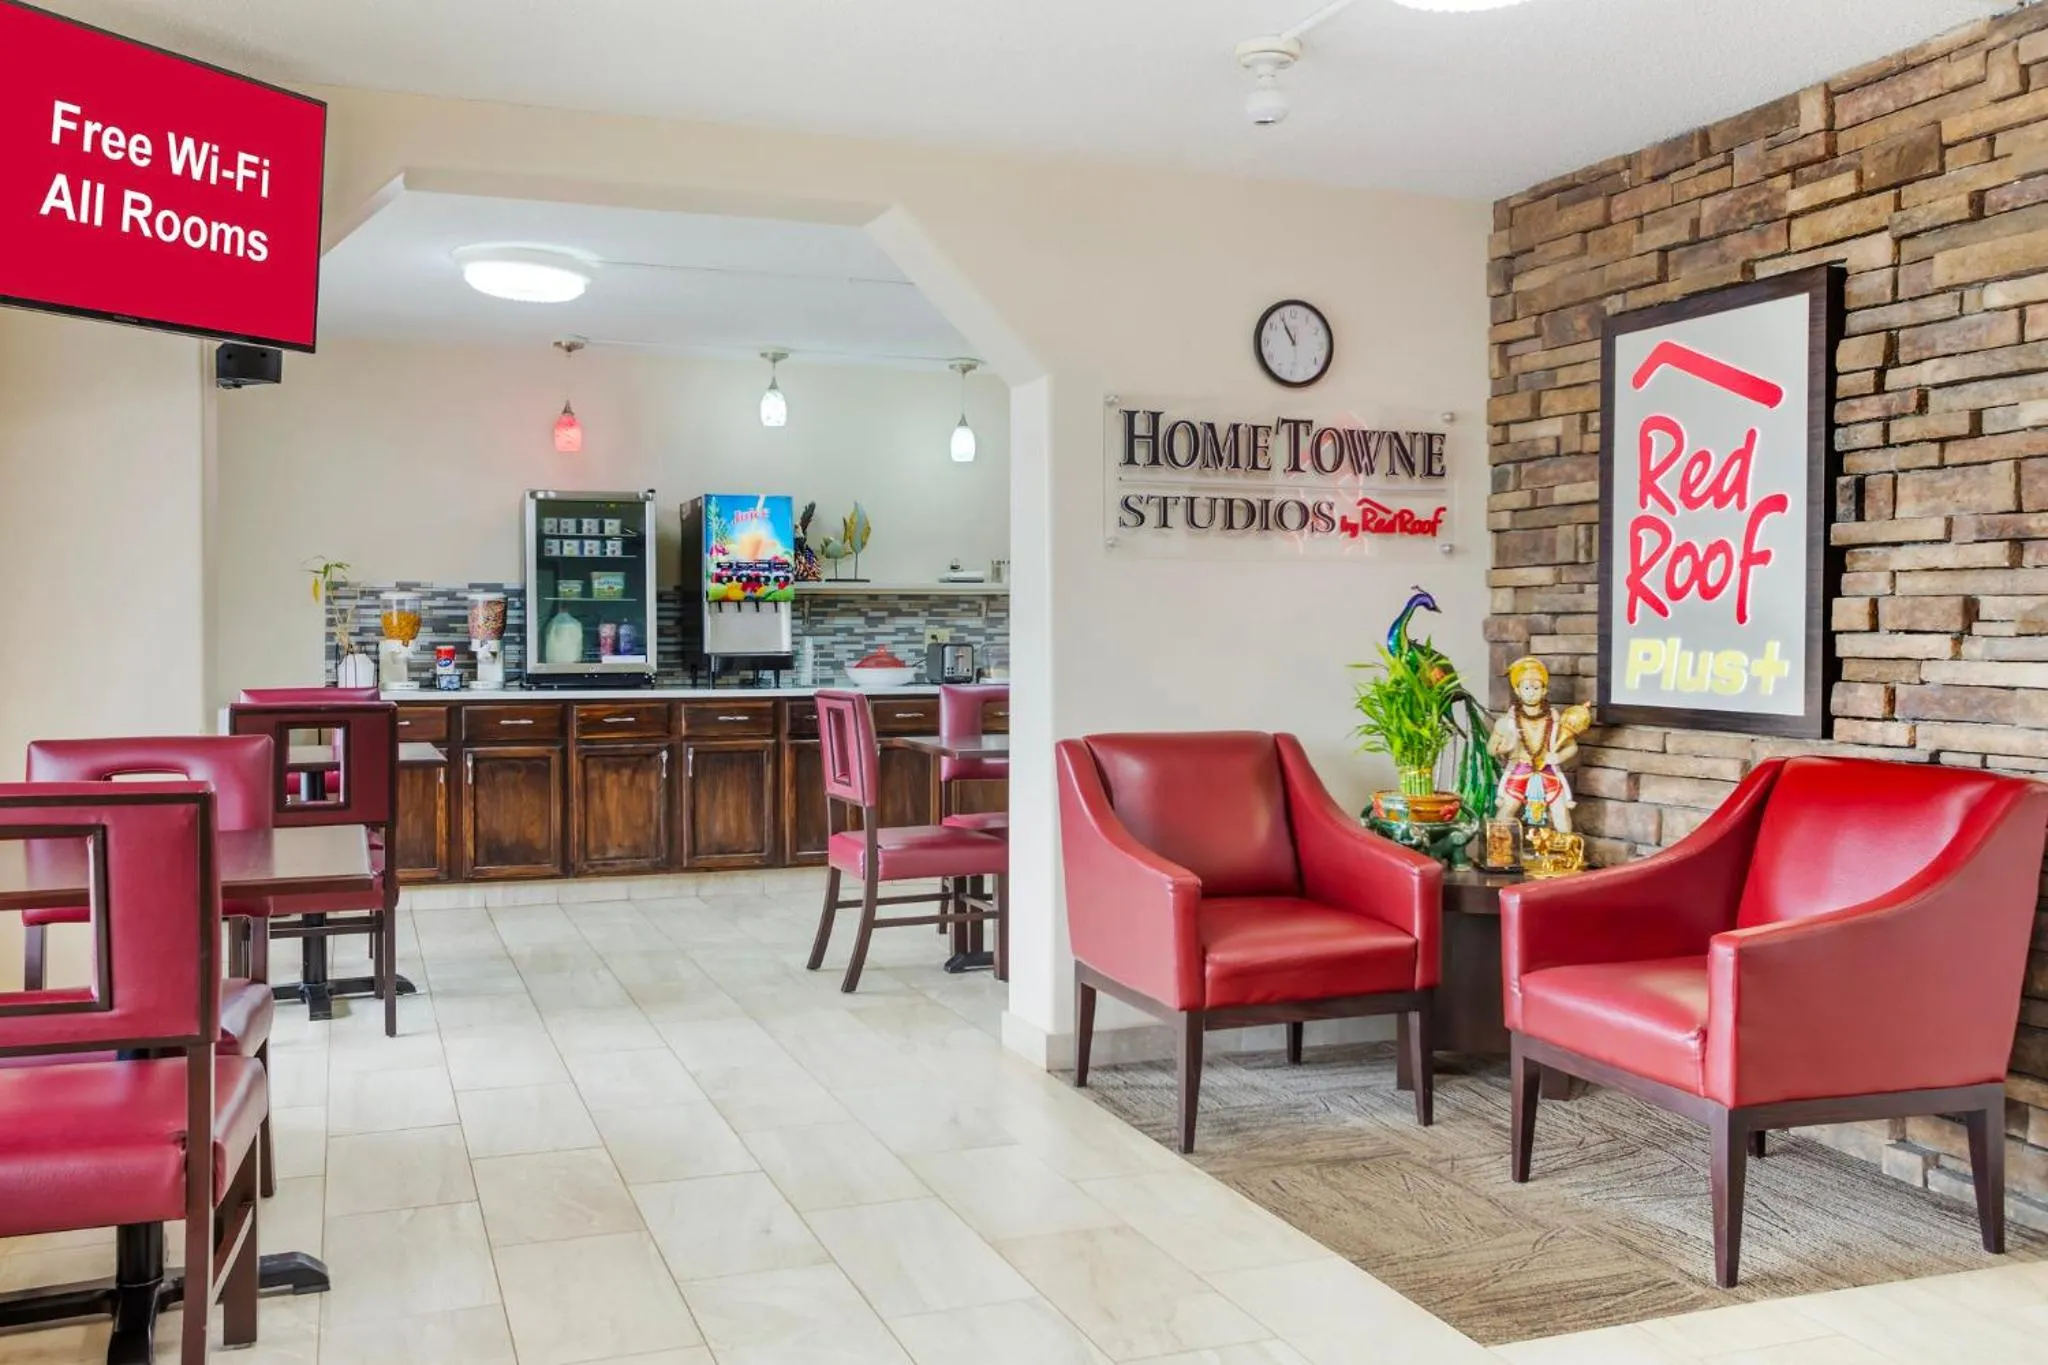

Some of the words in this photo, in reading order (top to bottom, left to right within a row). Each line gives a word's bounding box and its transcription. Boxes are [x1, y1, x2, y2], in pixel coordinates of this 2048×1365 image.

[51, 100, 152, 167] Free
[167, 131, 270, 199] Wi-Fi
[40, 173, 105, 227] All
[121, 189, 269, 262] Rooms
[1639, 415, 1757, 516] Red
[1119, 494, 1337, 534] STUDIOS
[1340, 515, 1359, 538] by
[1626, 493, 1789, 625] Roof
[1625, 637, 1790, 697] Plus+
